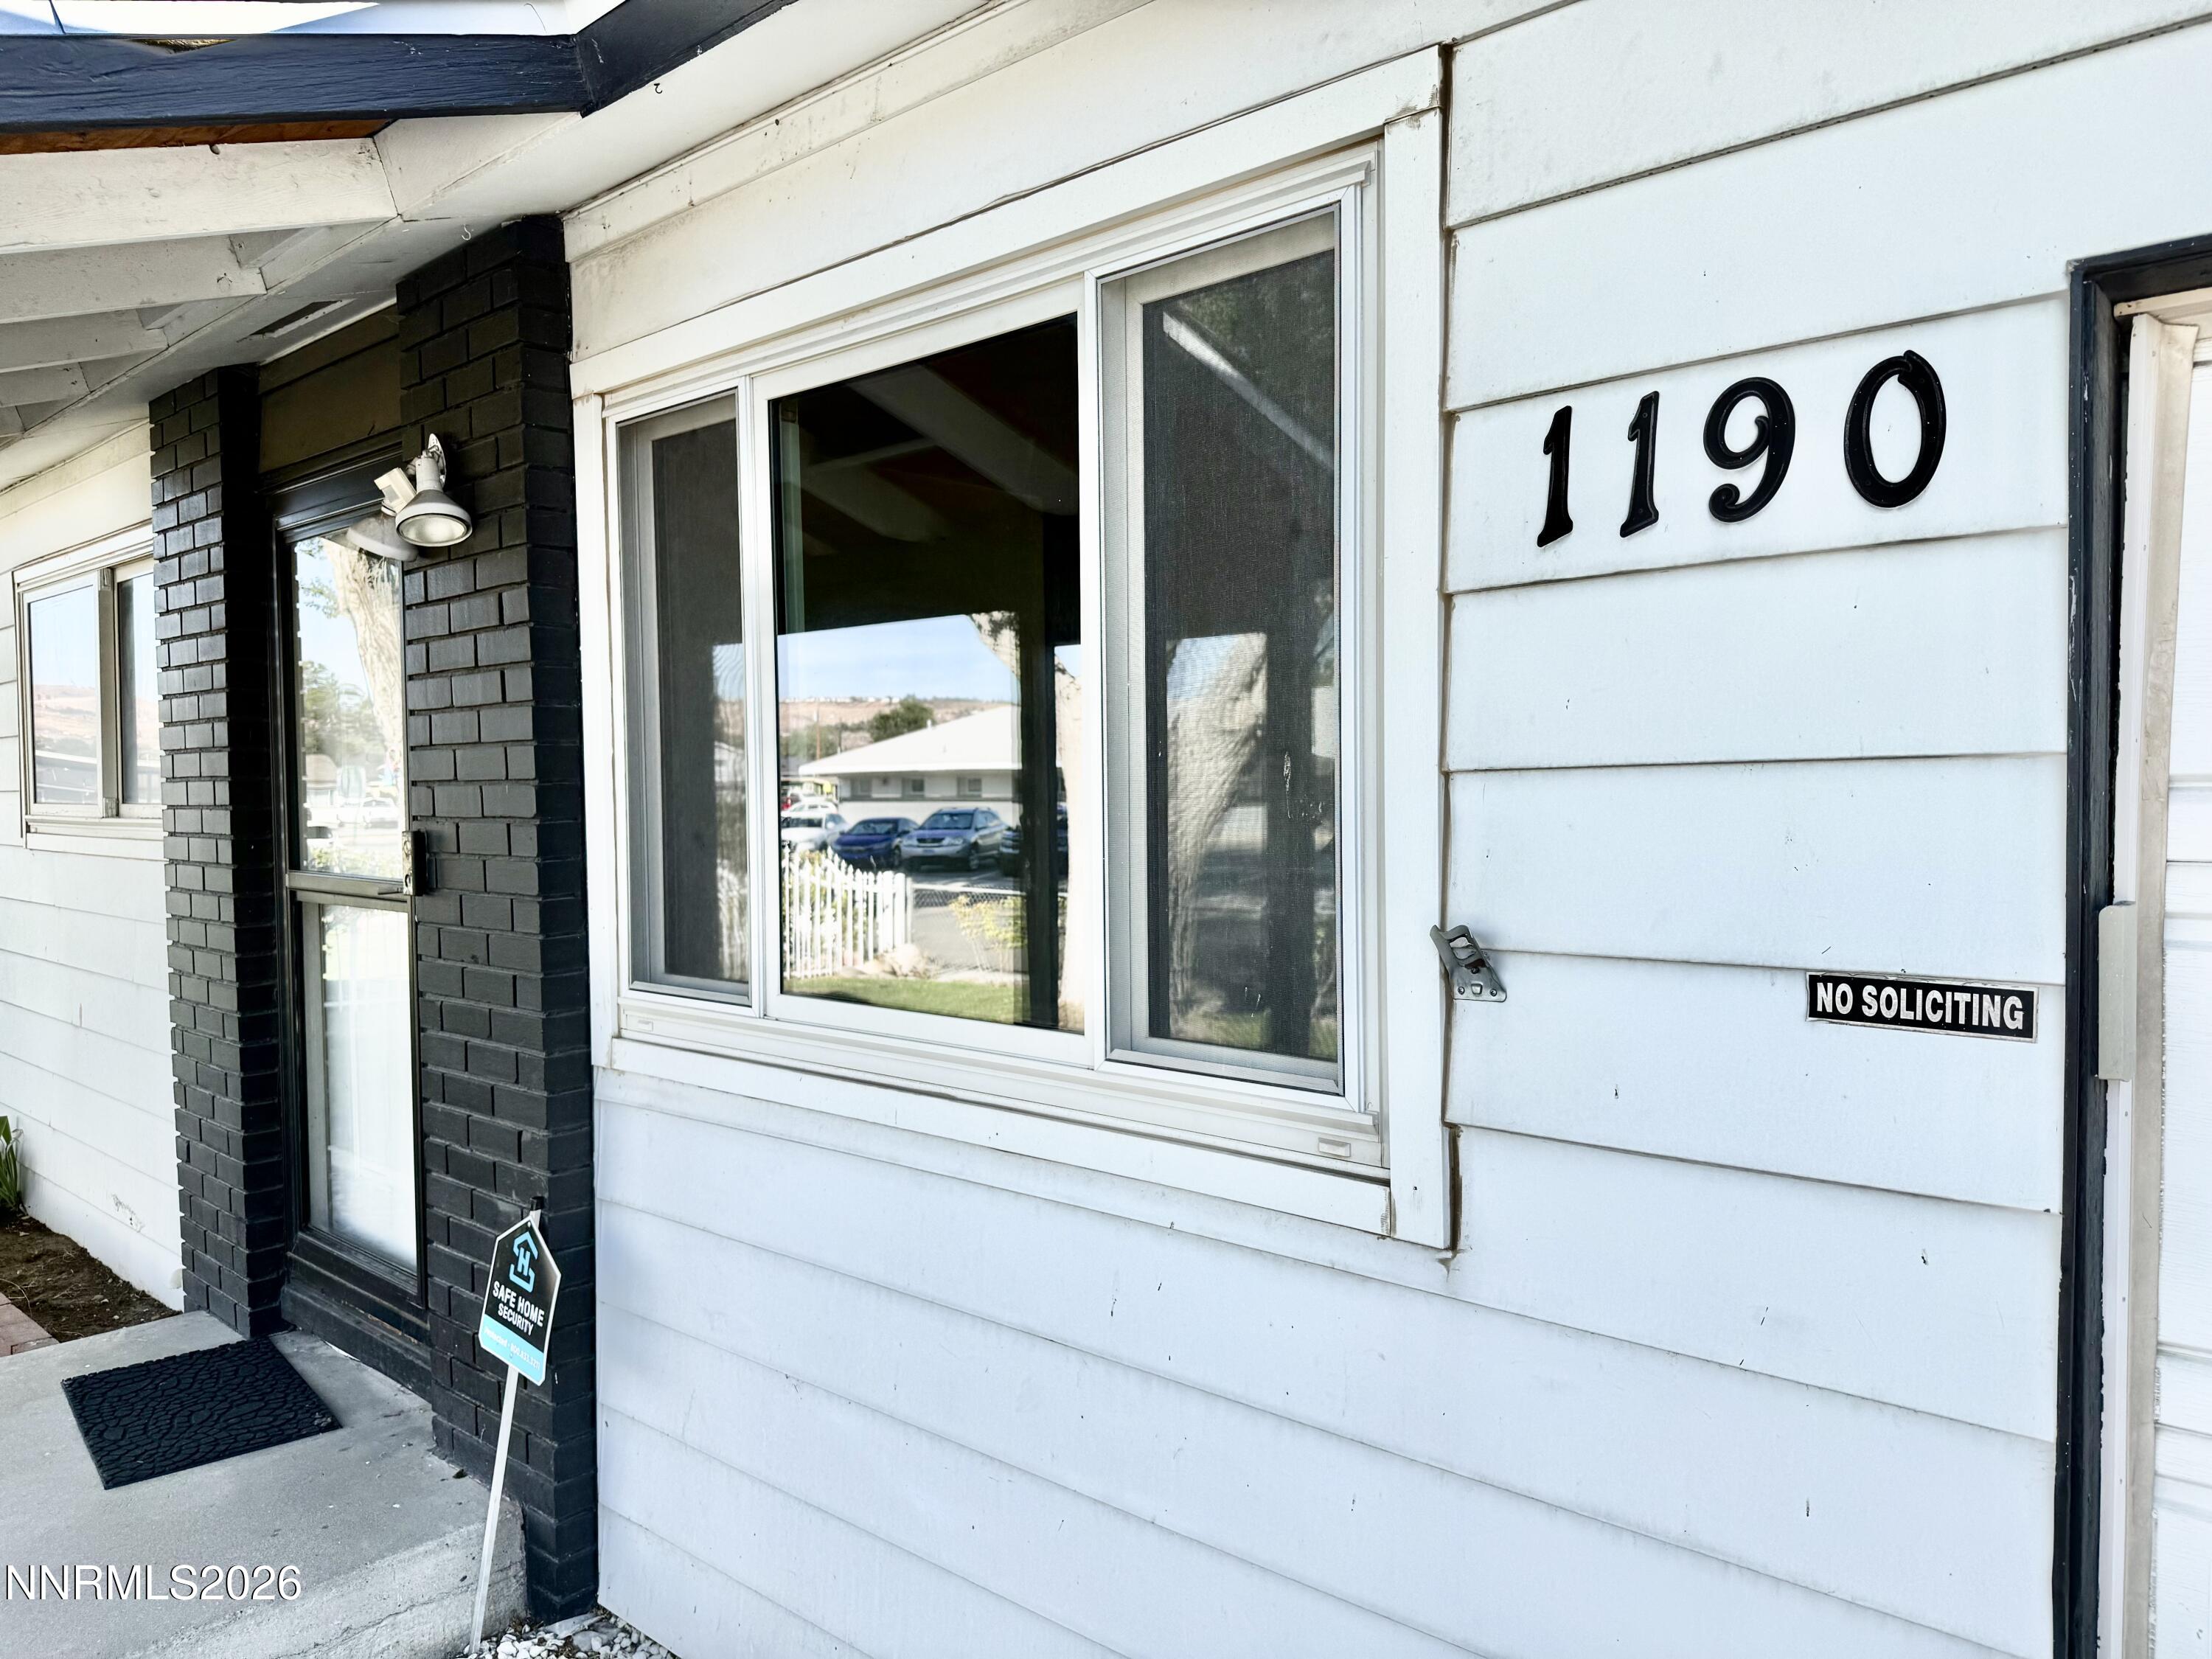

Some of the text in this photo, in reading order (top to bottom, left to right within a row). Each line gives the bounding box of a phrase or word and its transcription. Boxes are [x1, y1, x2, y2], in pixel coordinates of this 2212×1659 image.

[1537, 349, 1947, 548] 1190
[1816, 982, 2023, 1030] NO SOLICITING
[493, 1281, 544, 1327] SAFE HOME
[498, 1303, 534, 1336] SECURITY
